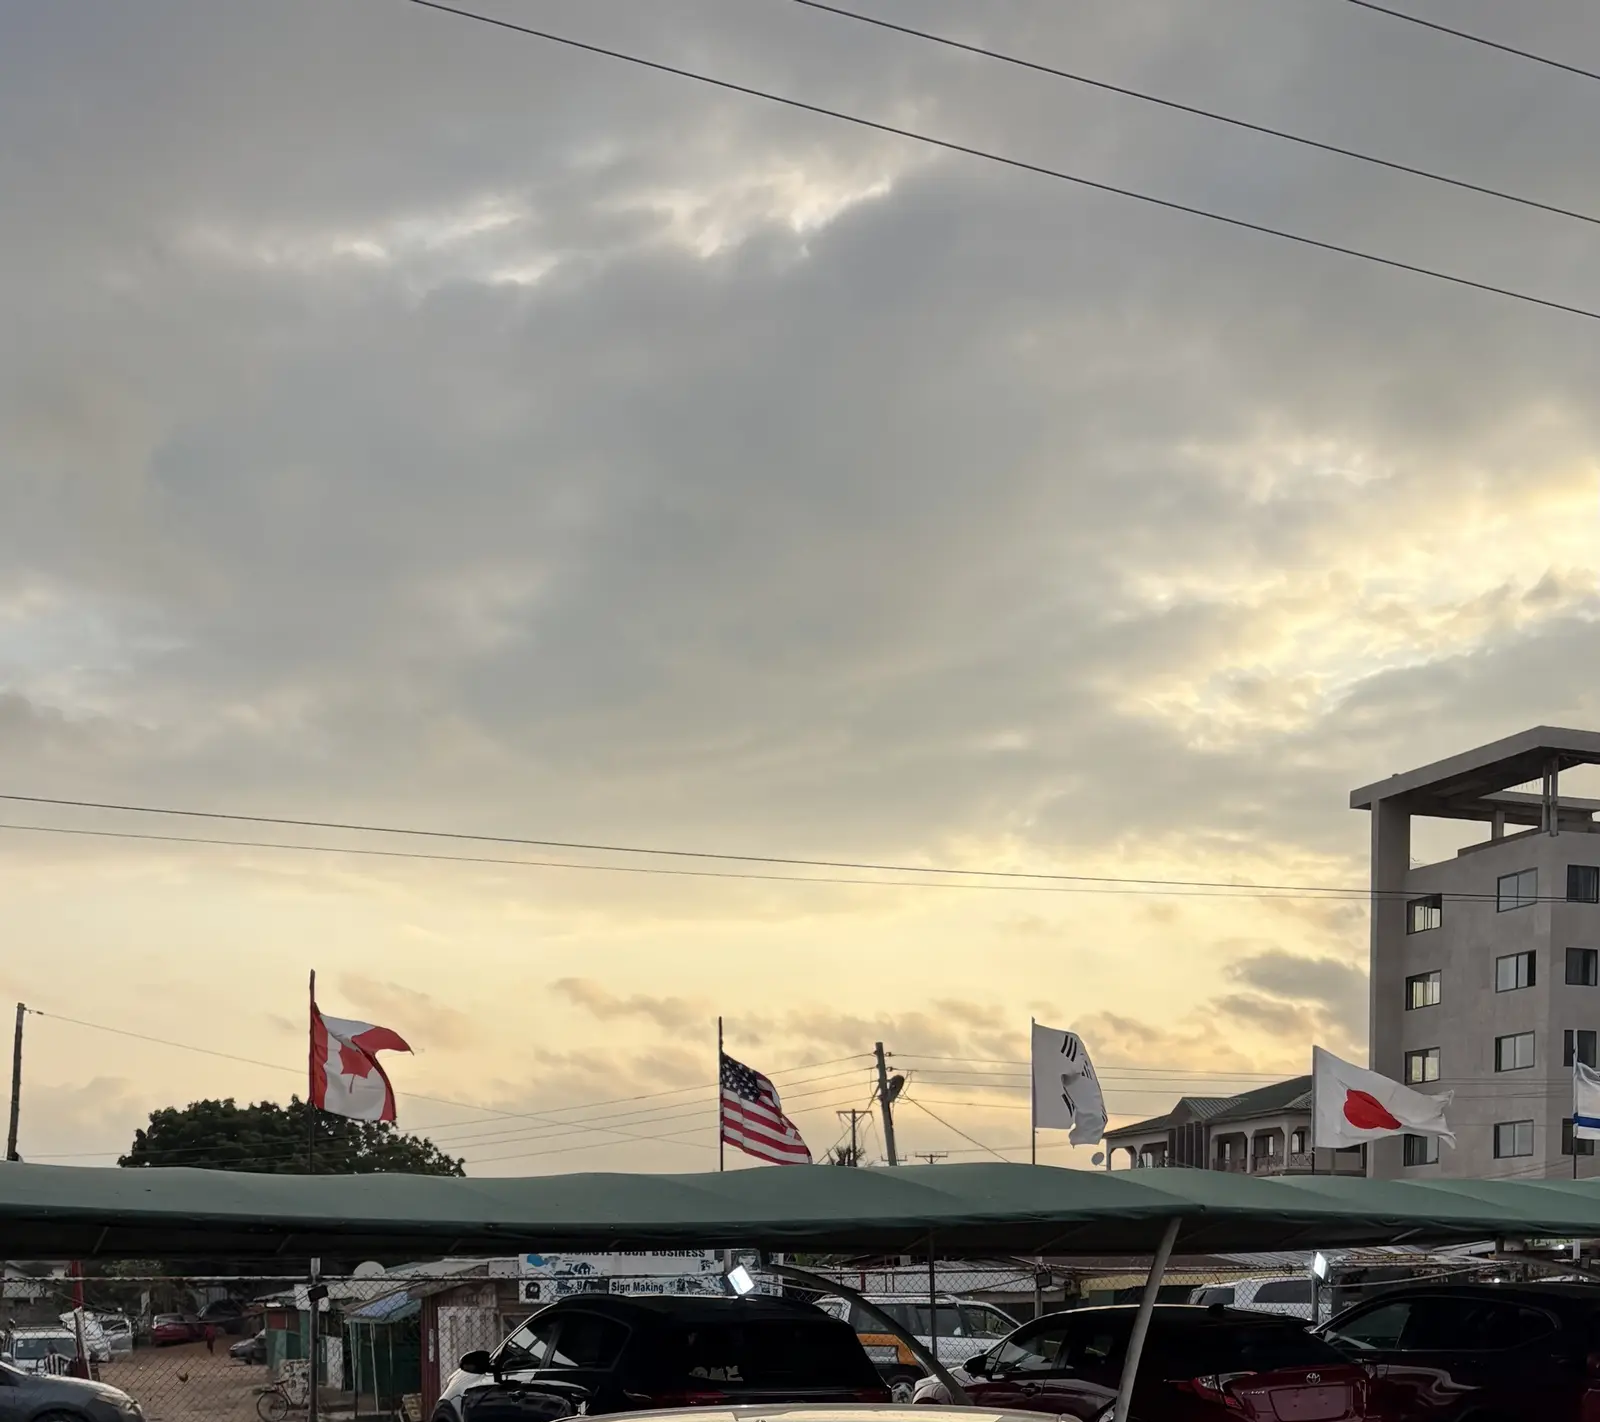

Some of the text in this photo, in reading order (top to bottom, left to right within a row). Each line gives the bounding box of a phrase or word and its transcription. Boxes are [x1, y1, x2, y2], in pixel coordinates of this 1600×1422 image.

[651, 1250, 705, 1258] BUSINESS
[611, 1281, 664, 1294] Sign Making
